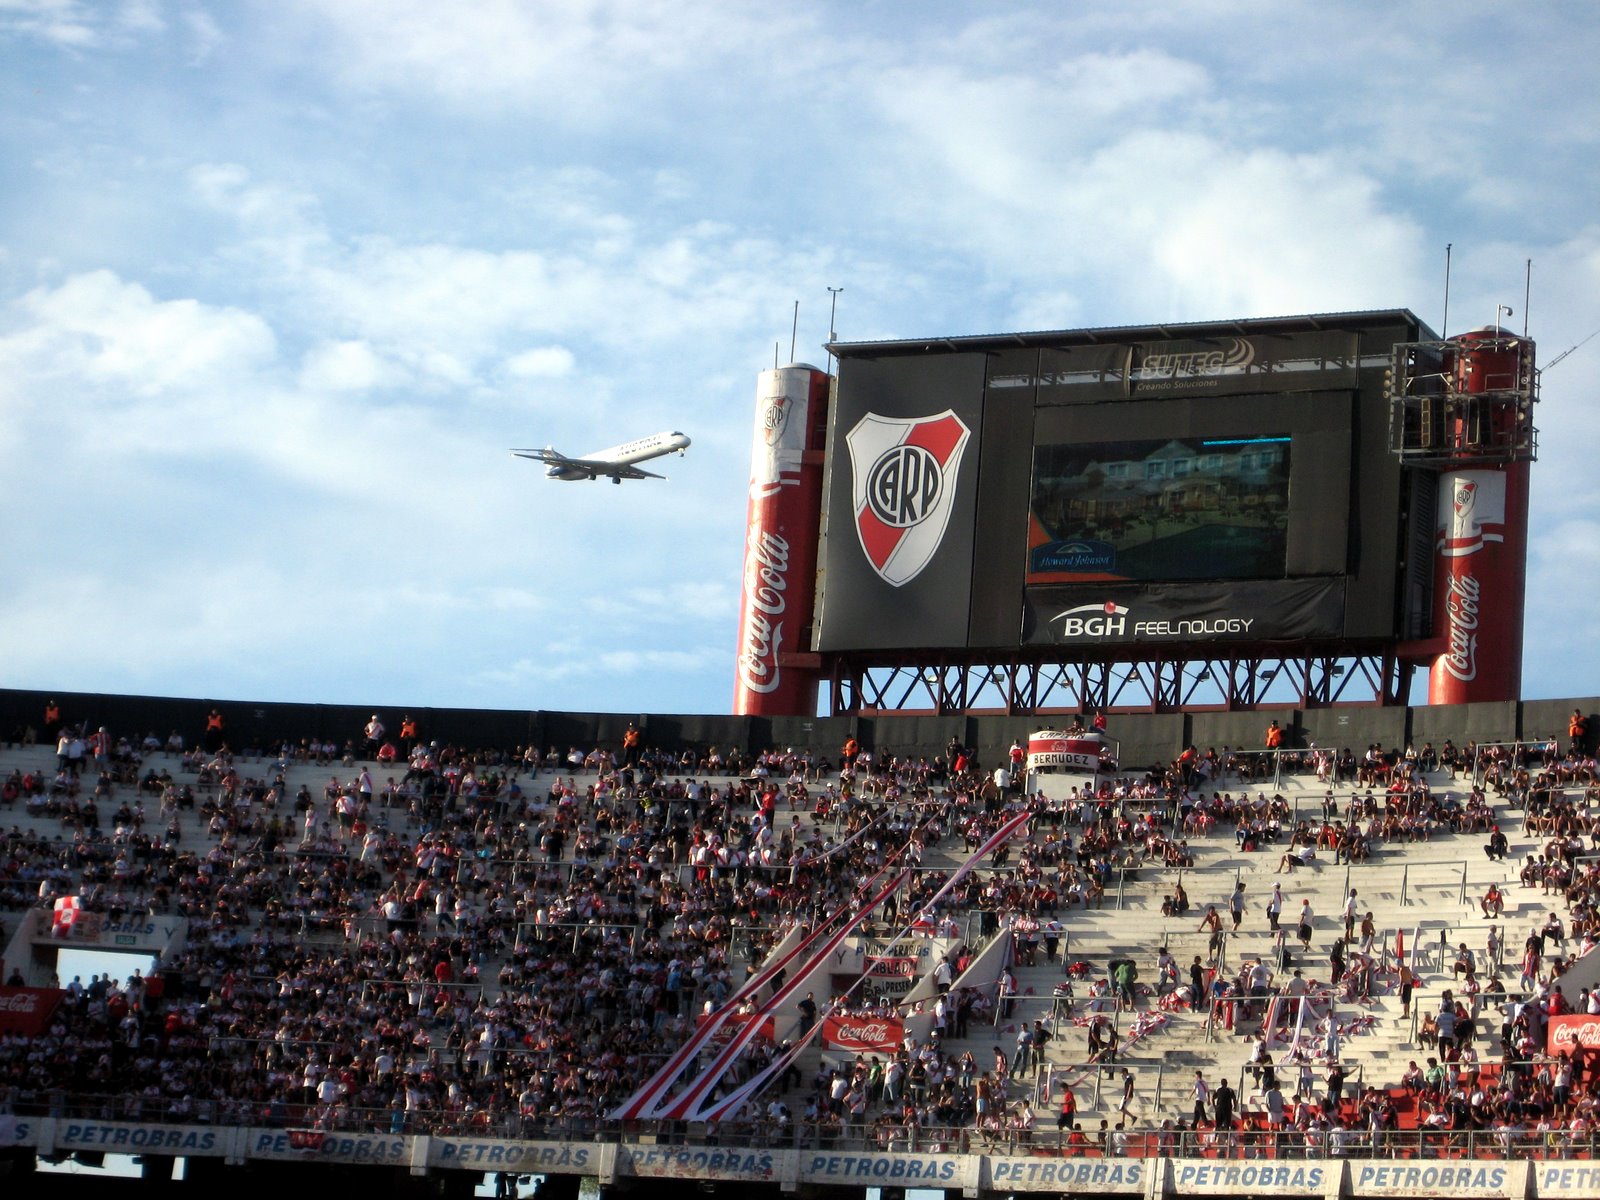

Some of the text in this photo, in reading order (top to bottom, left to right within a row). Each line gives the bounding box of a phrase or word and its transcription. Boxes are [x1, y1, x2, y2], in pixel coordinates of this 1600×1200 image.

[1137, 379, 1218, 391] Creando Soluciones
[869, 447, 939, 524] CARP
[1040, 555, 1075, 567] Howard
[1064, 617, 1254, 636] BGH FEELNOLOGY
[1034, 754, 1089, 766] BERMUDEZ
[64, 1125, 215, 1149] PETROBRAS
[256, 1134, 405, 1159] PEOBRAS
[440, 1143, 589, 1167] PETROBRAS
[630, 1150, 773, 1173] PETROBRAS
[810, 1157, 956, 1180] PETROBRAS
[993, 1163, 1141, 1184] PETROBRAS
[1180, 1166, 1323, 1187] PETROBRAS
[1358, 1167, 1506, 1188] PETROBRAS
